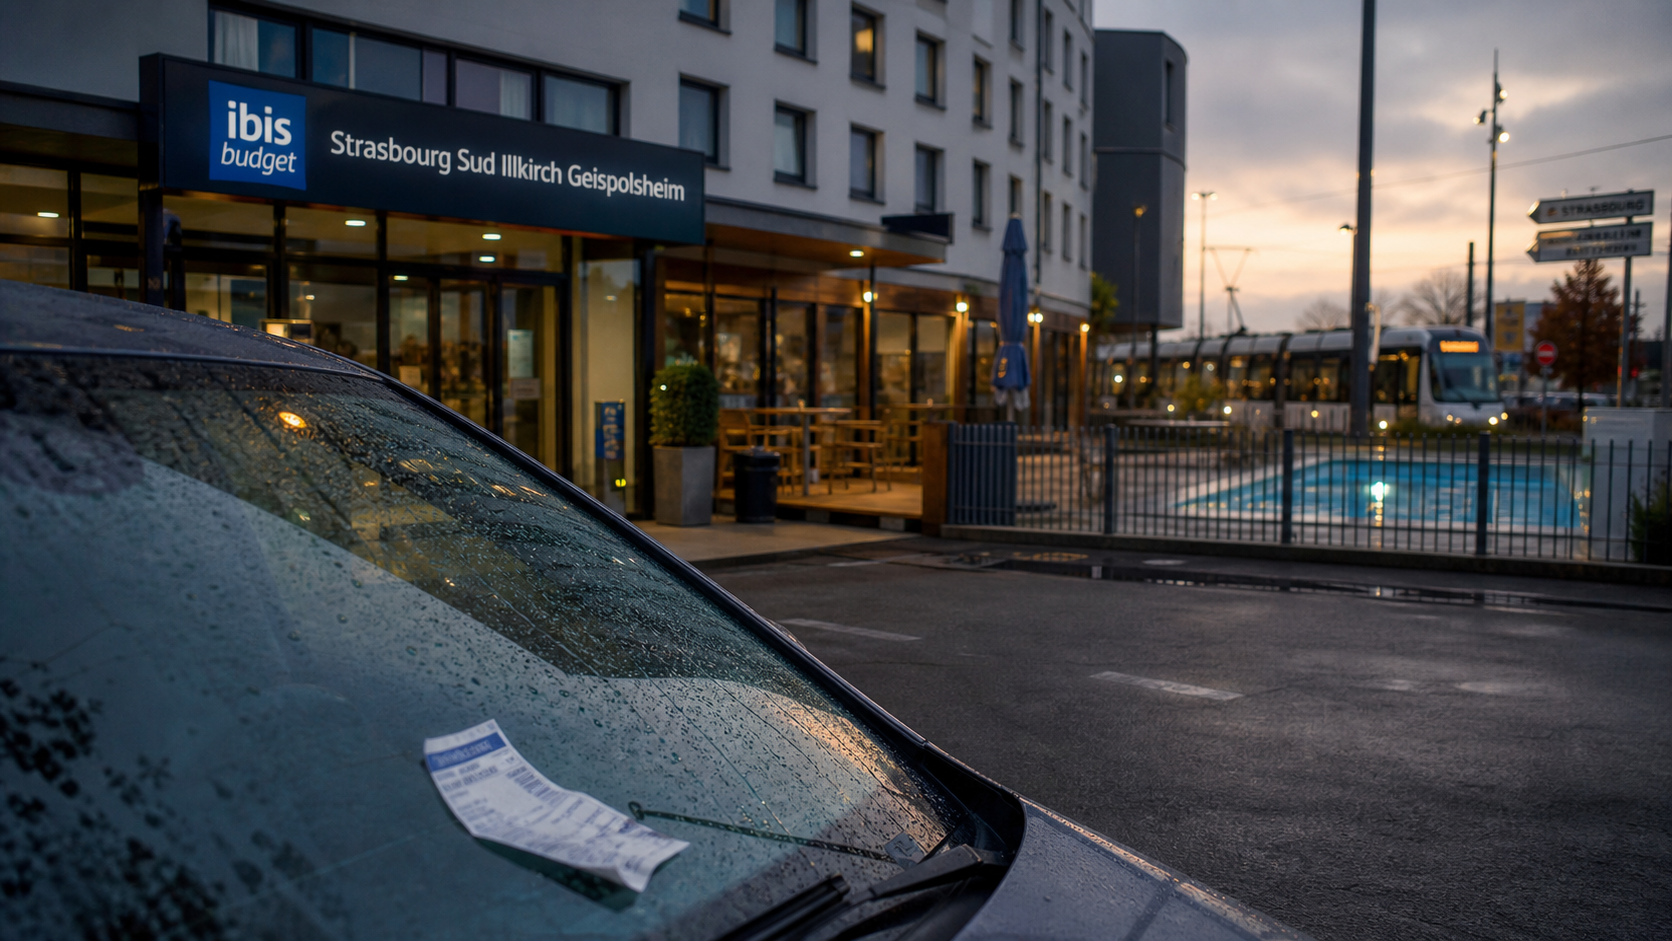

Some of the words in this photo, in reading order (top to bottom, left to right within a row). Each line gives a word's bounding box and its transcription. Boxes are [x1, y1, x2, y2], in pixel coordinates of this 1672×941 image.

[226, 100, 293, 146] ibis
[220, 141, 297, 176] budget
[330, 130, 452, 176] Strasbourg
[457, 148, 497, 176] Sud
[501, 153, 563, 186] Illkirch
[567, 164, 686, 202] Geispolsheim
[1561, 200, 1645, 216] STRASBOURG
